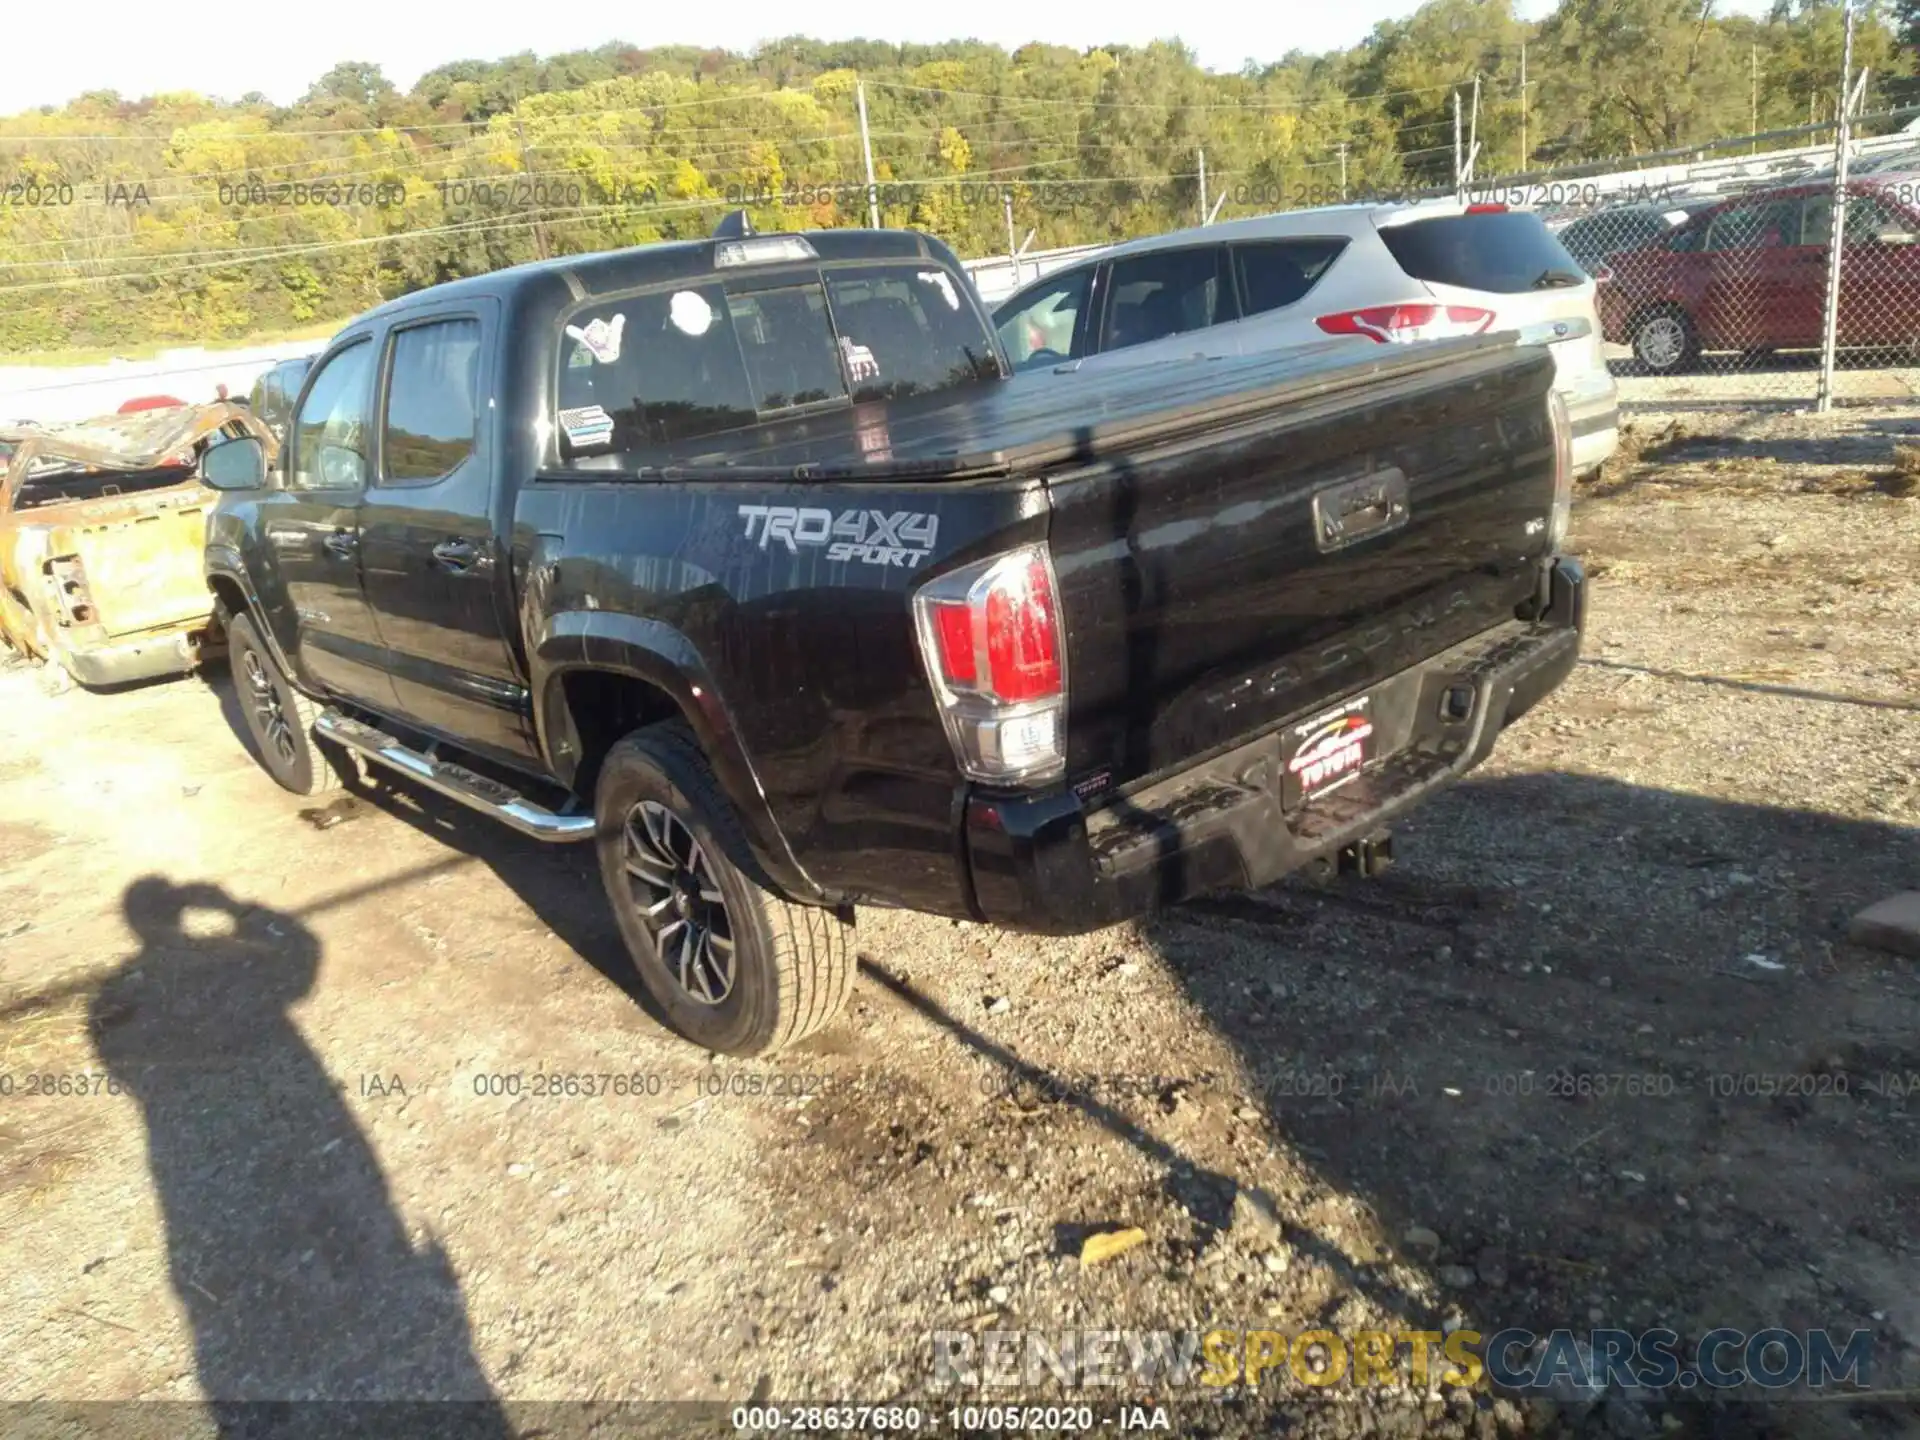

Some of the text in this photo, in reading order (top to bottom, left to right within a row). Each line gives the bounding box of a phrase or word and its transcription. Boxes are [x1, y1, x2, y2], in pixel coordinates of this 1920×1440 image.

[737, 504, 940, 554] TRD 4X4
[825, 542, 932, 568] SPORT
